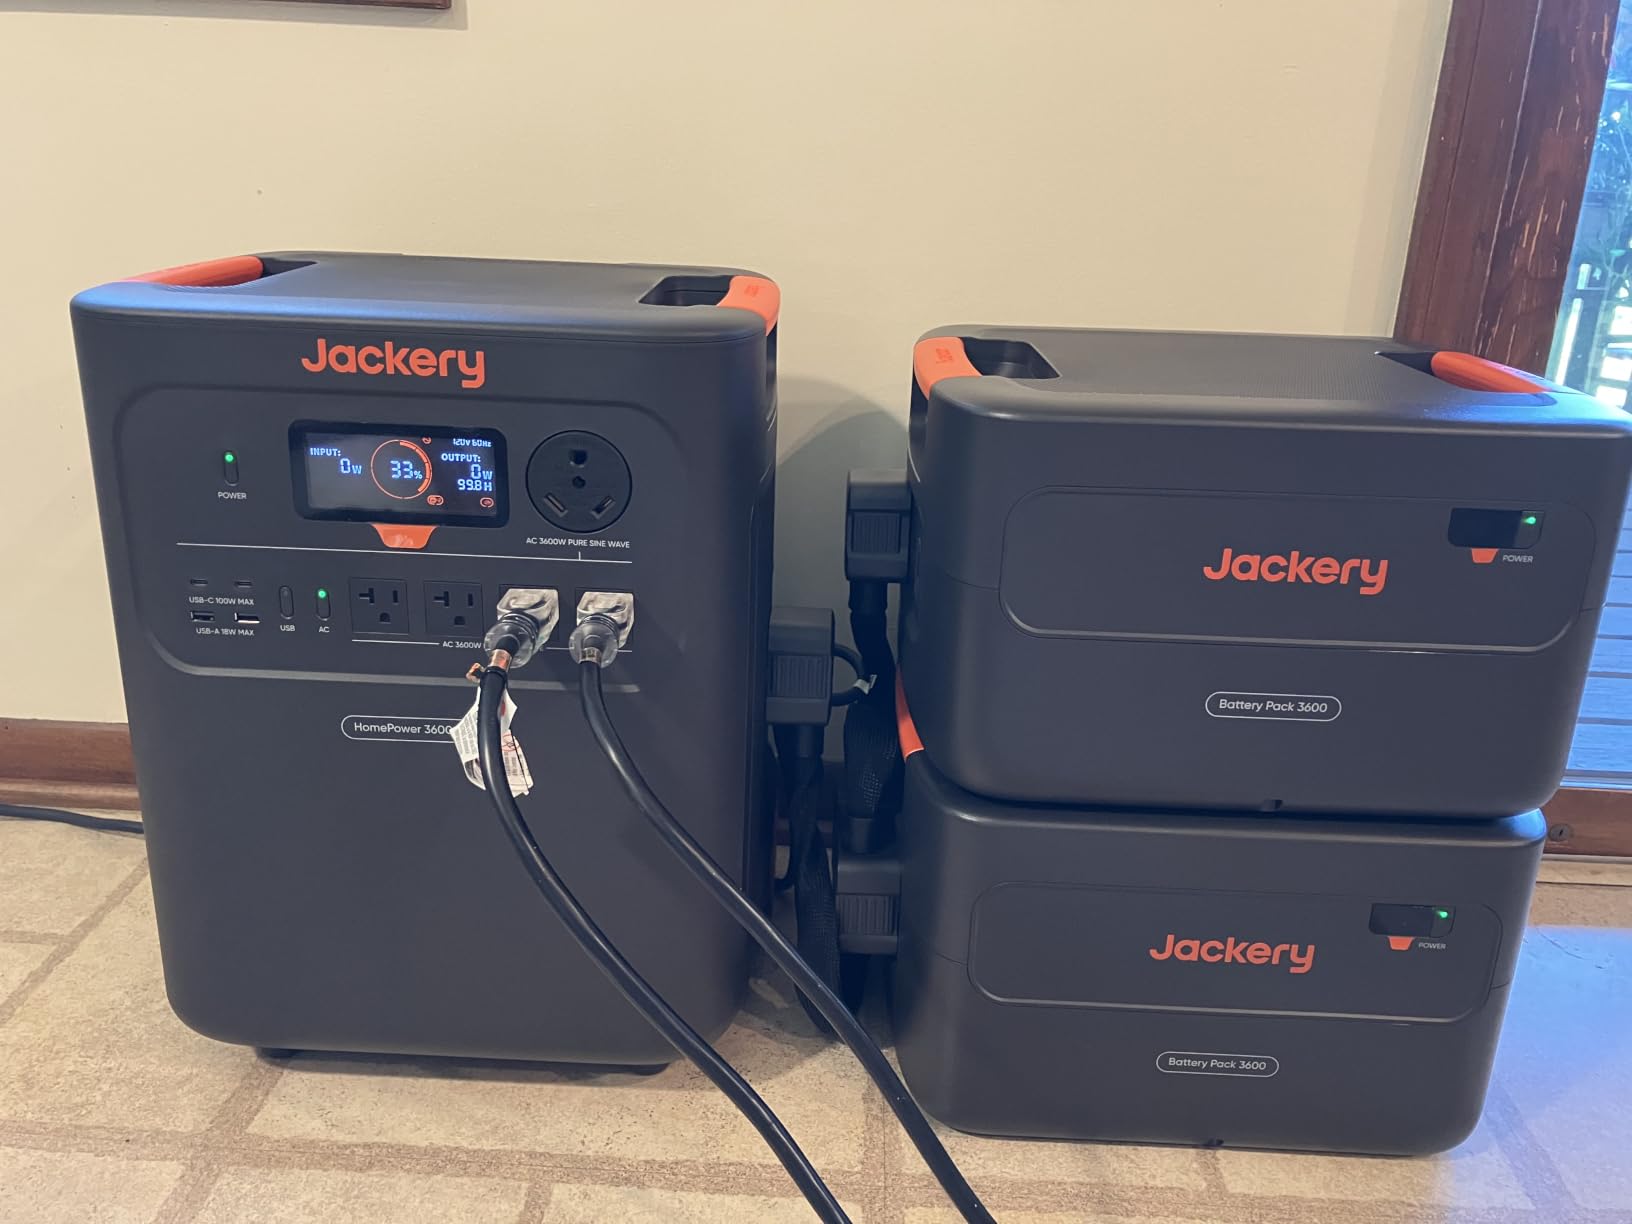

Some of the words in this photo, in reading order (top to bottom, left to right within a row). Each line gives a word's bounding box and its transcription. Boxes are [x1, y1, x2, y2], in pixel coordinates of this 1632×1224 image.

[301, 338, 485, 389] Jackery
[310, 447, 341, 457] INPUT:
[441, 453, 481, 463] OUTPUT:
[390, 460, 423, 479] 33%
[217, 491, 247, 501] POWER
[526, 537, 538, 545] AC
[539, 538, 567, 546] 3600W
[568, 539, 588, 547] PURE
[589, 540, 607, 548] SINE
[608, 541, 631, 549] WAVE
[1501, 554, 1534, 564] POWER
[1203, 548, 1388, 595] Jackery
[188, 596, 215, 605] USB-C
[215, 597, 237, 606] 100W
[237, 598, 255, 606] MAX
[196, 628, 221, 636] USB-A
[221, 629, 237, 637] 18W
[280, 625, 296, 633] USB
[318, 626, 331, 634] AC
[442, 641, 455, 649] AC
[455, 642, 482, 650] 3600W
[1218, 699, 1263, 715] Battery
[1264, 700, 1295, 713] Pack
[1296, 702, 1329, 714] 3600
[354, 722, 422, 735] HomePower
[1418, 941, 1447, 950] POWER
[1149, 934, 1315, 974] Jackery
[1168, 1056, 1209, 1071] Battery
[1210, 1058, 1237, 1069] Pack
[1238, 1059, 1267, 1071] 3600
